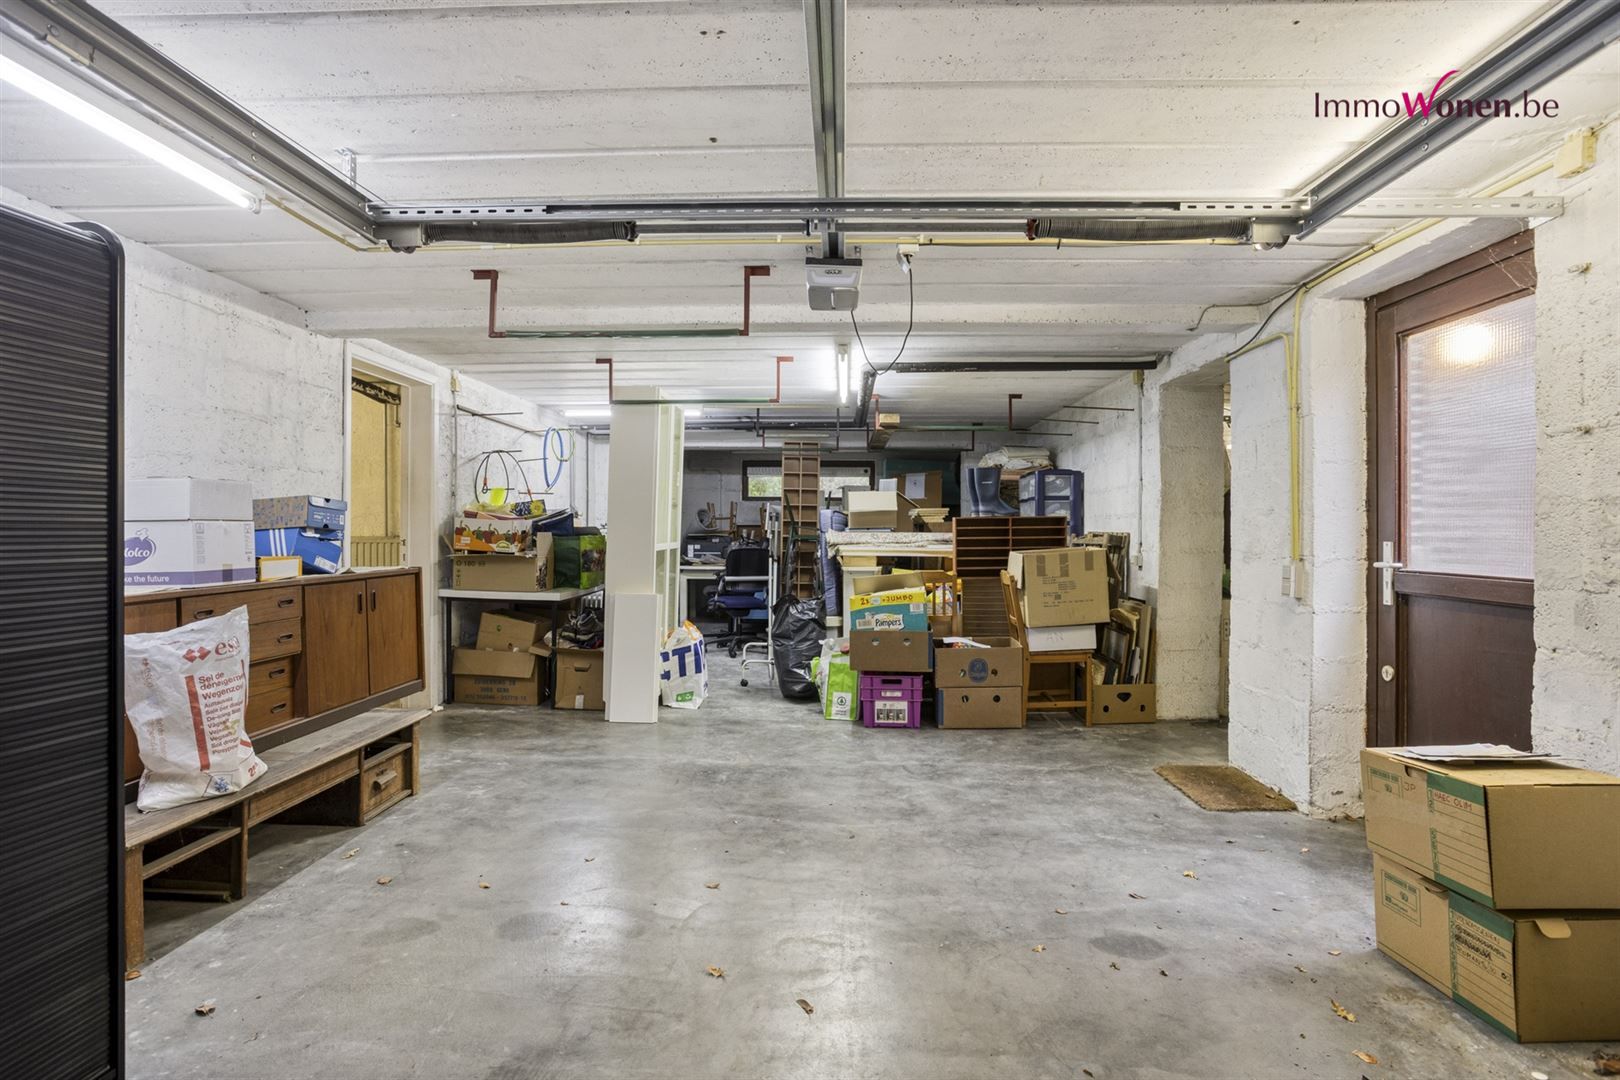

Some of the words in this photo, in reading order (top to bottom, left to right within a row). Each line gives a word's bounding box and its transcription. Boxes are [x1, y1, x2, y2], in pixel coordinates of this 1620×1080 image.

[133, 575, 146, 583] the
[147, 574, 170, 583] future
[875, 618, 902, 629] Pampers
[198, 674, 214, 684] Sel
[214, 671, 225, 680] de
